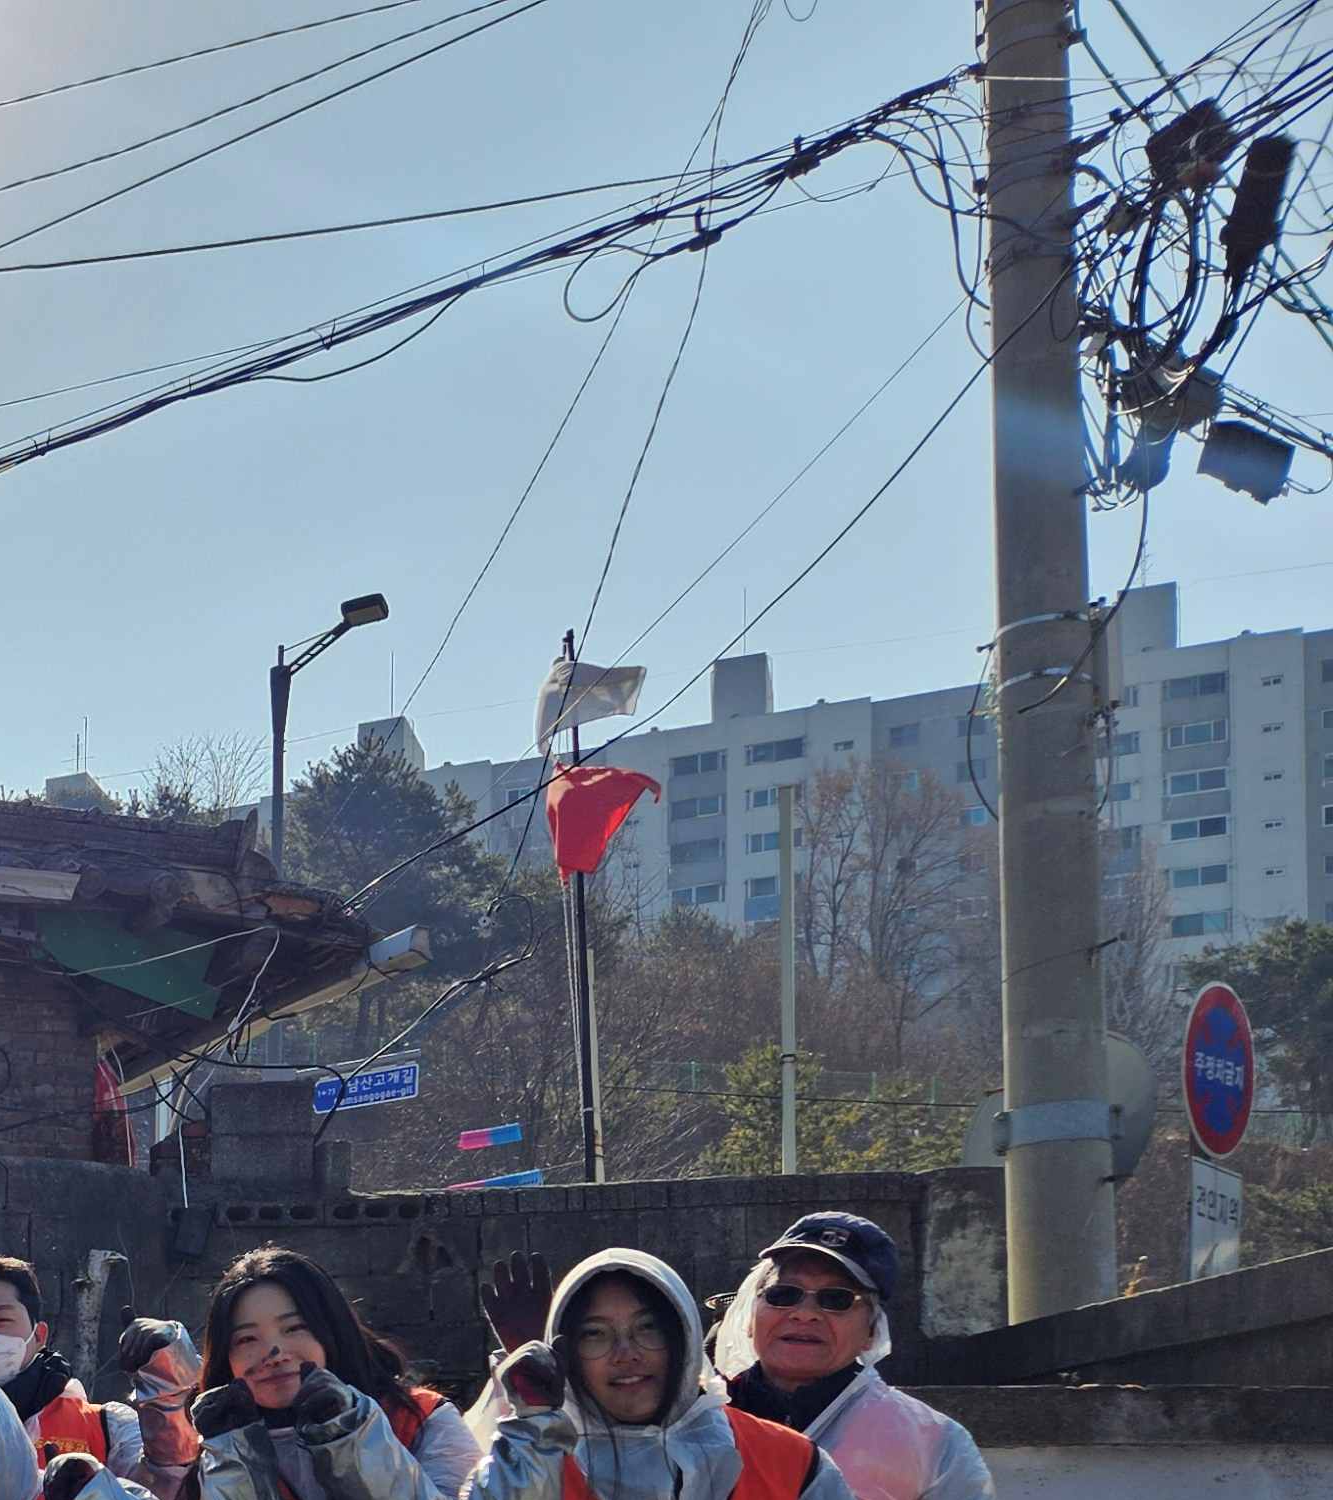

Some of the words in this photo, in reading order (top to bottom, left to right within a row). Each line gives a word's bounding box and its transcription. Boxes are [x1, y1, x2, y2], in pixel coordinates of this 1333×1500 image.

[346, 1067, 414, 1094] 남산고개길
[1194, 1051, 1244, 1090] 주정차금지
[1196, 1185, 1241, 1228] 견인지역
